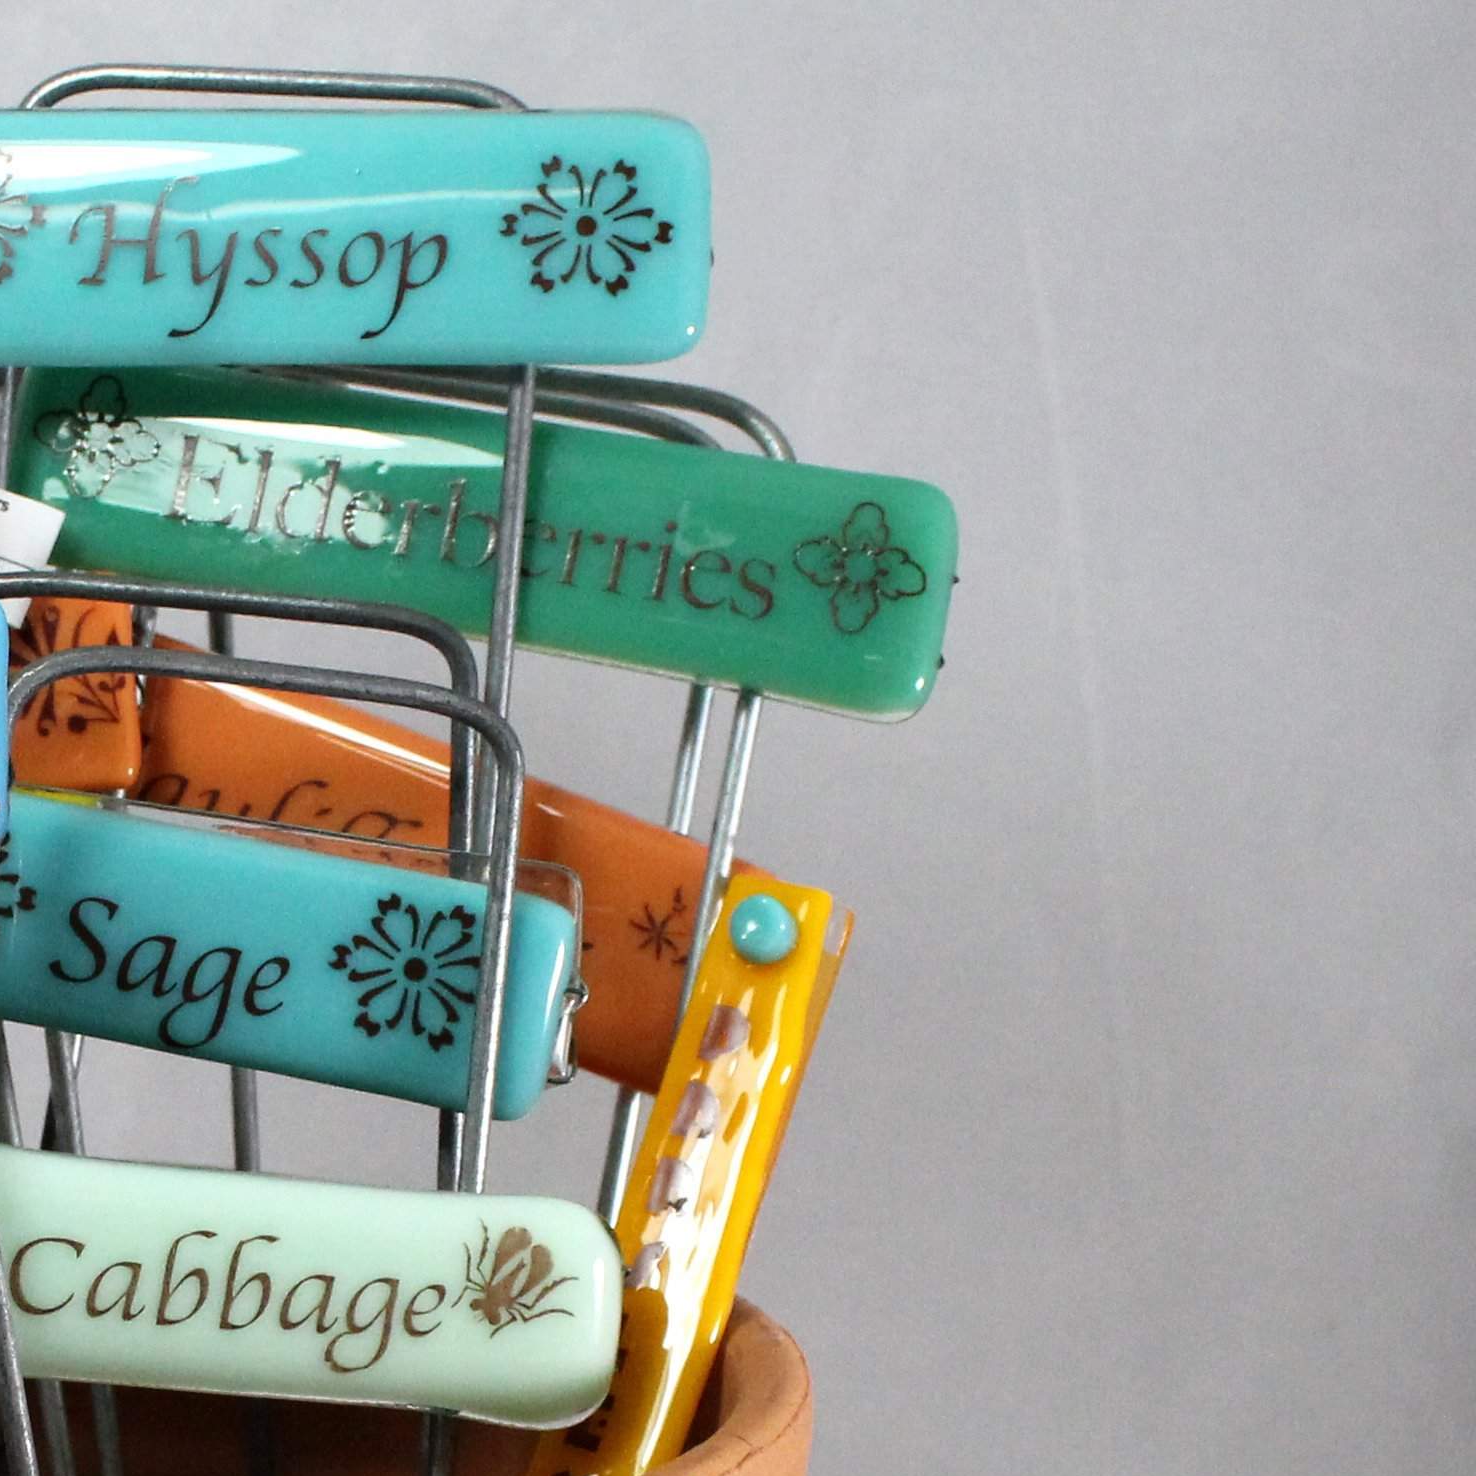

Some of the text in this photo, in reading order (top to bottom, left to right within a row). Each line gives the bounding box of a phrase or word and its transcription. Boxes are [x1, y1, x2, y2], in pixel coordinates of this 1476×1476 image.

[69, 175, 449, 339] Hyssop
[167, 434, 777, 621] Elderberries
[49, 896, 293, 1051] Sage
[10, 1229, 446, 1373] Cabbage
